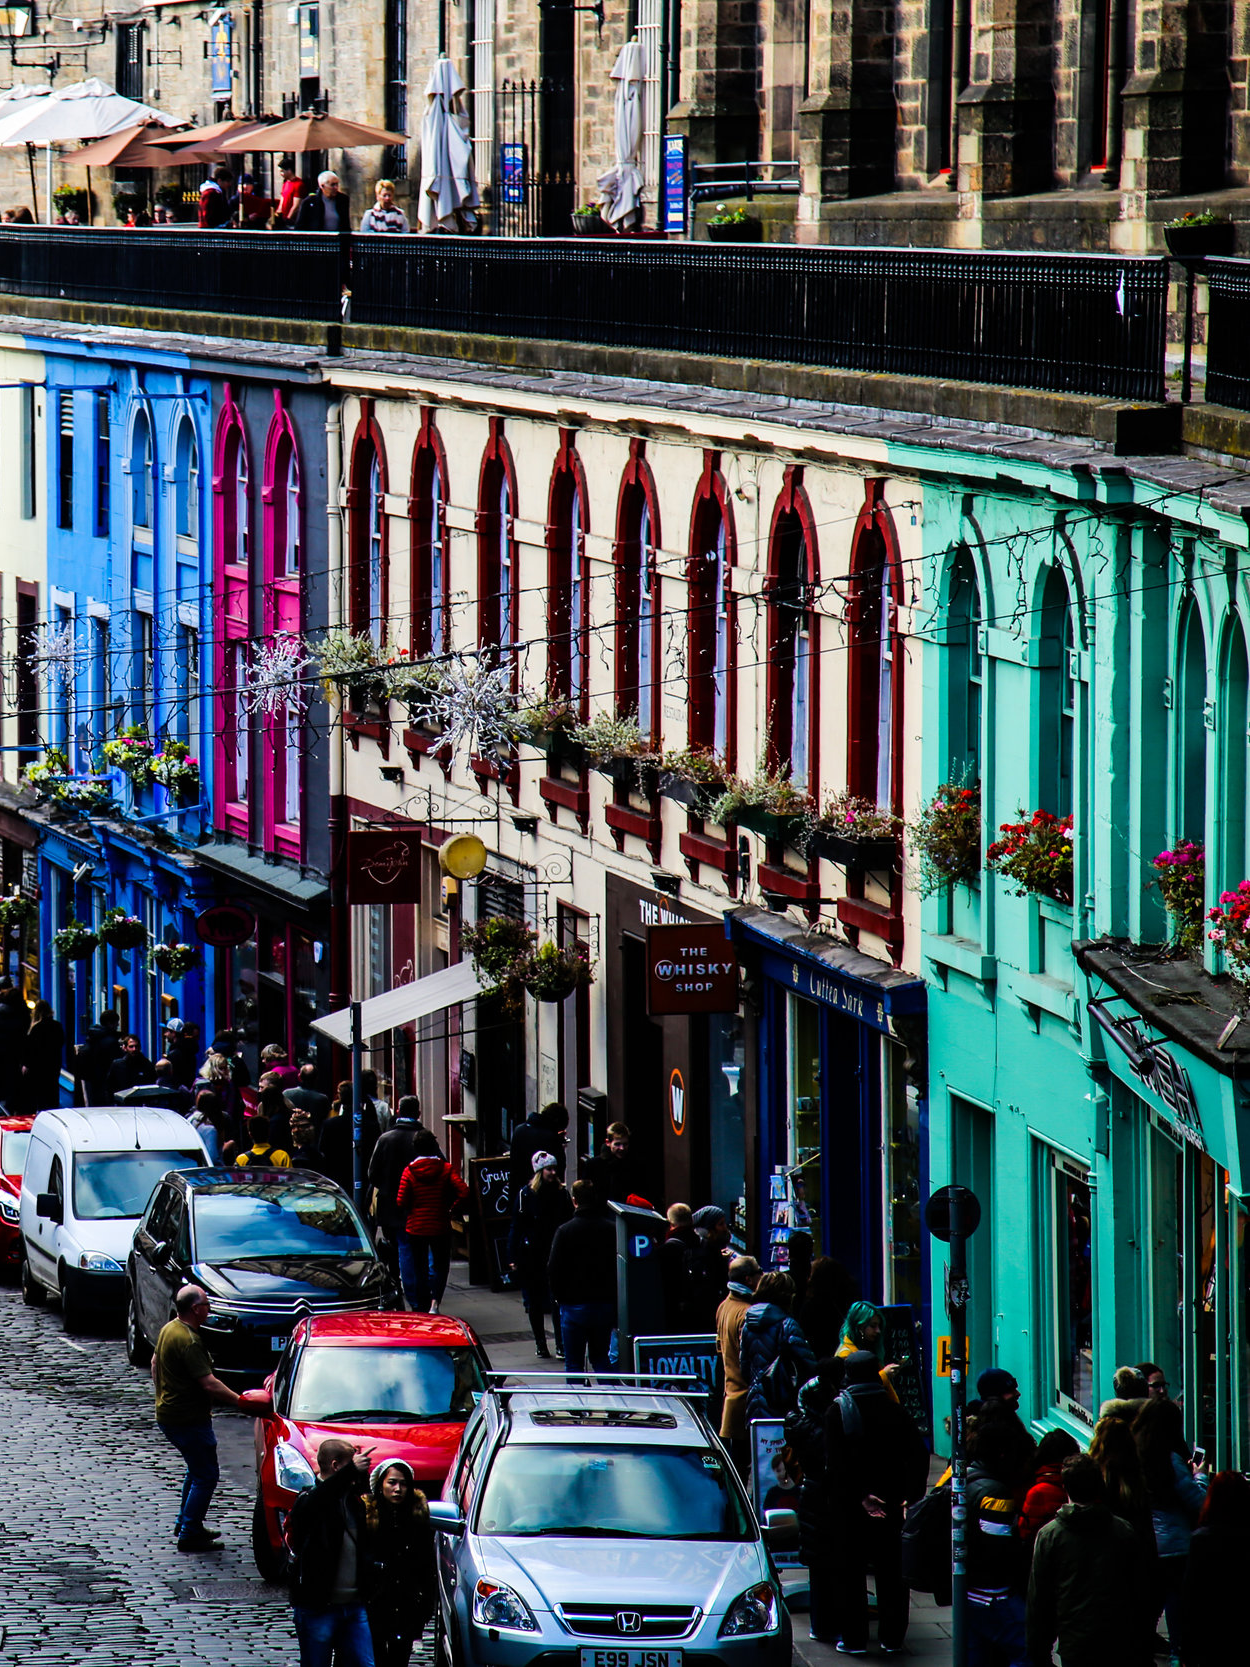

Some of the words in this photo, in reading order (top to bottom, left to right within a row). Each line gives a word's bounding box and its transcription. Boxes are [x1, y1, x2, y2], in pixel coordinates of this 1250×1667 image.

[639, 899, 658, 925] THE
[680, 947, 708, 956] THE
[657, 963, 733, 976] WHISKY
[676, 982, 713, 992] SHOP
[841, 983, 863, 1017] Sark
[671, 1084, 684, 1124] W
[635, 1235, 649, 1257] P
[648, 1355, 718, 1388] LOYALTY
[594, 1651, 629, 1667] E99
[635, 1652, 669, 1667] JSN
